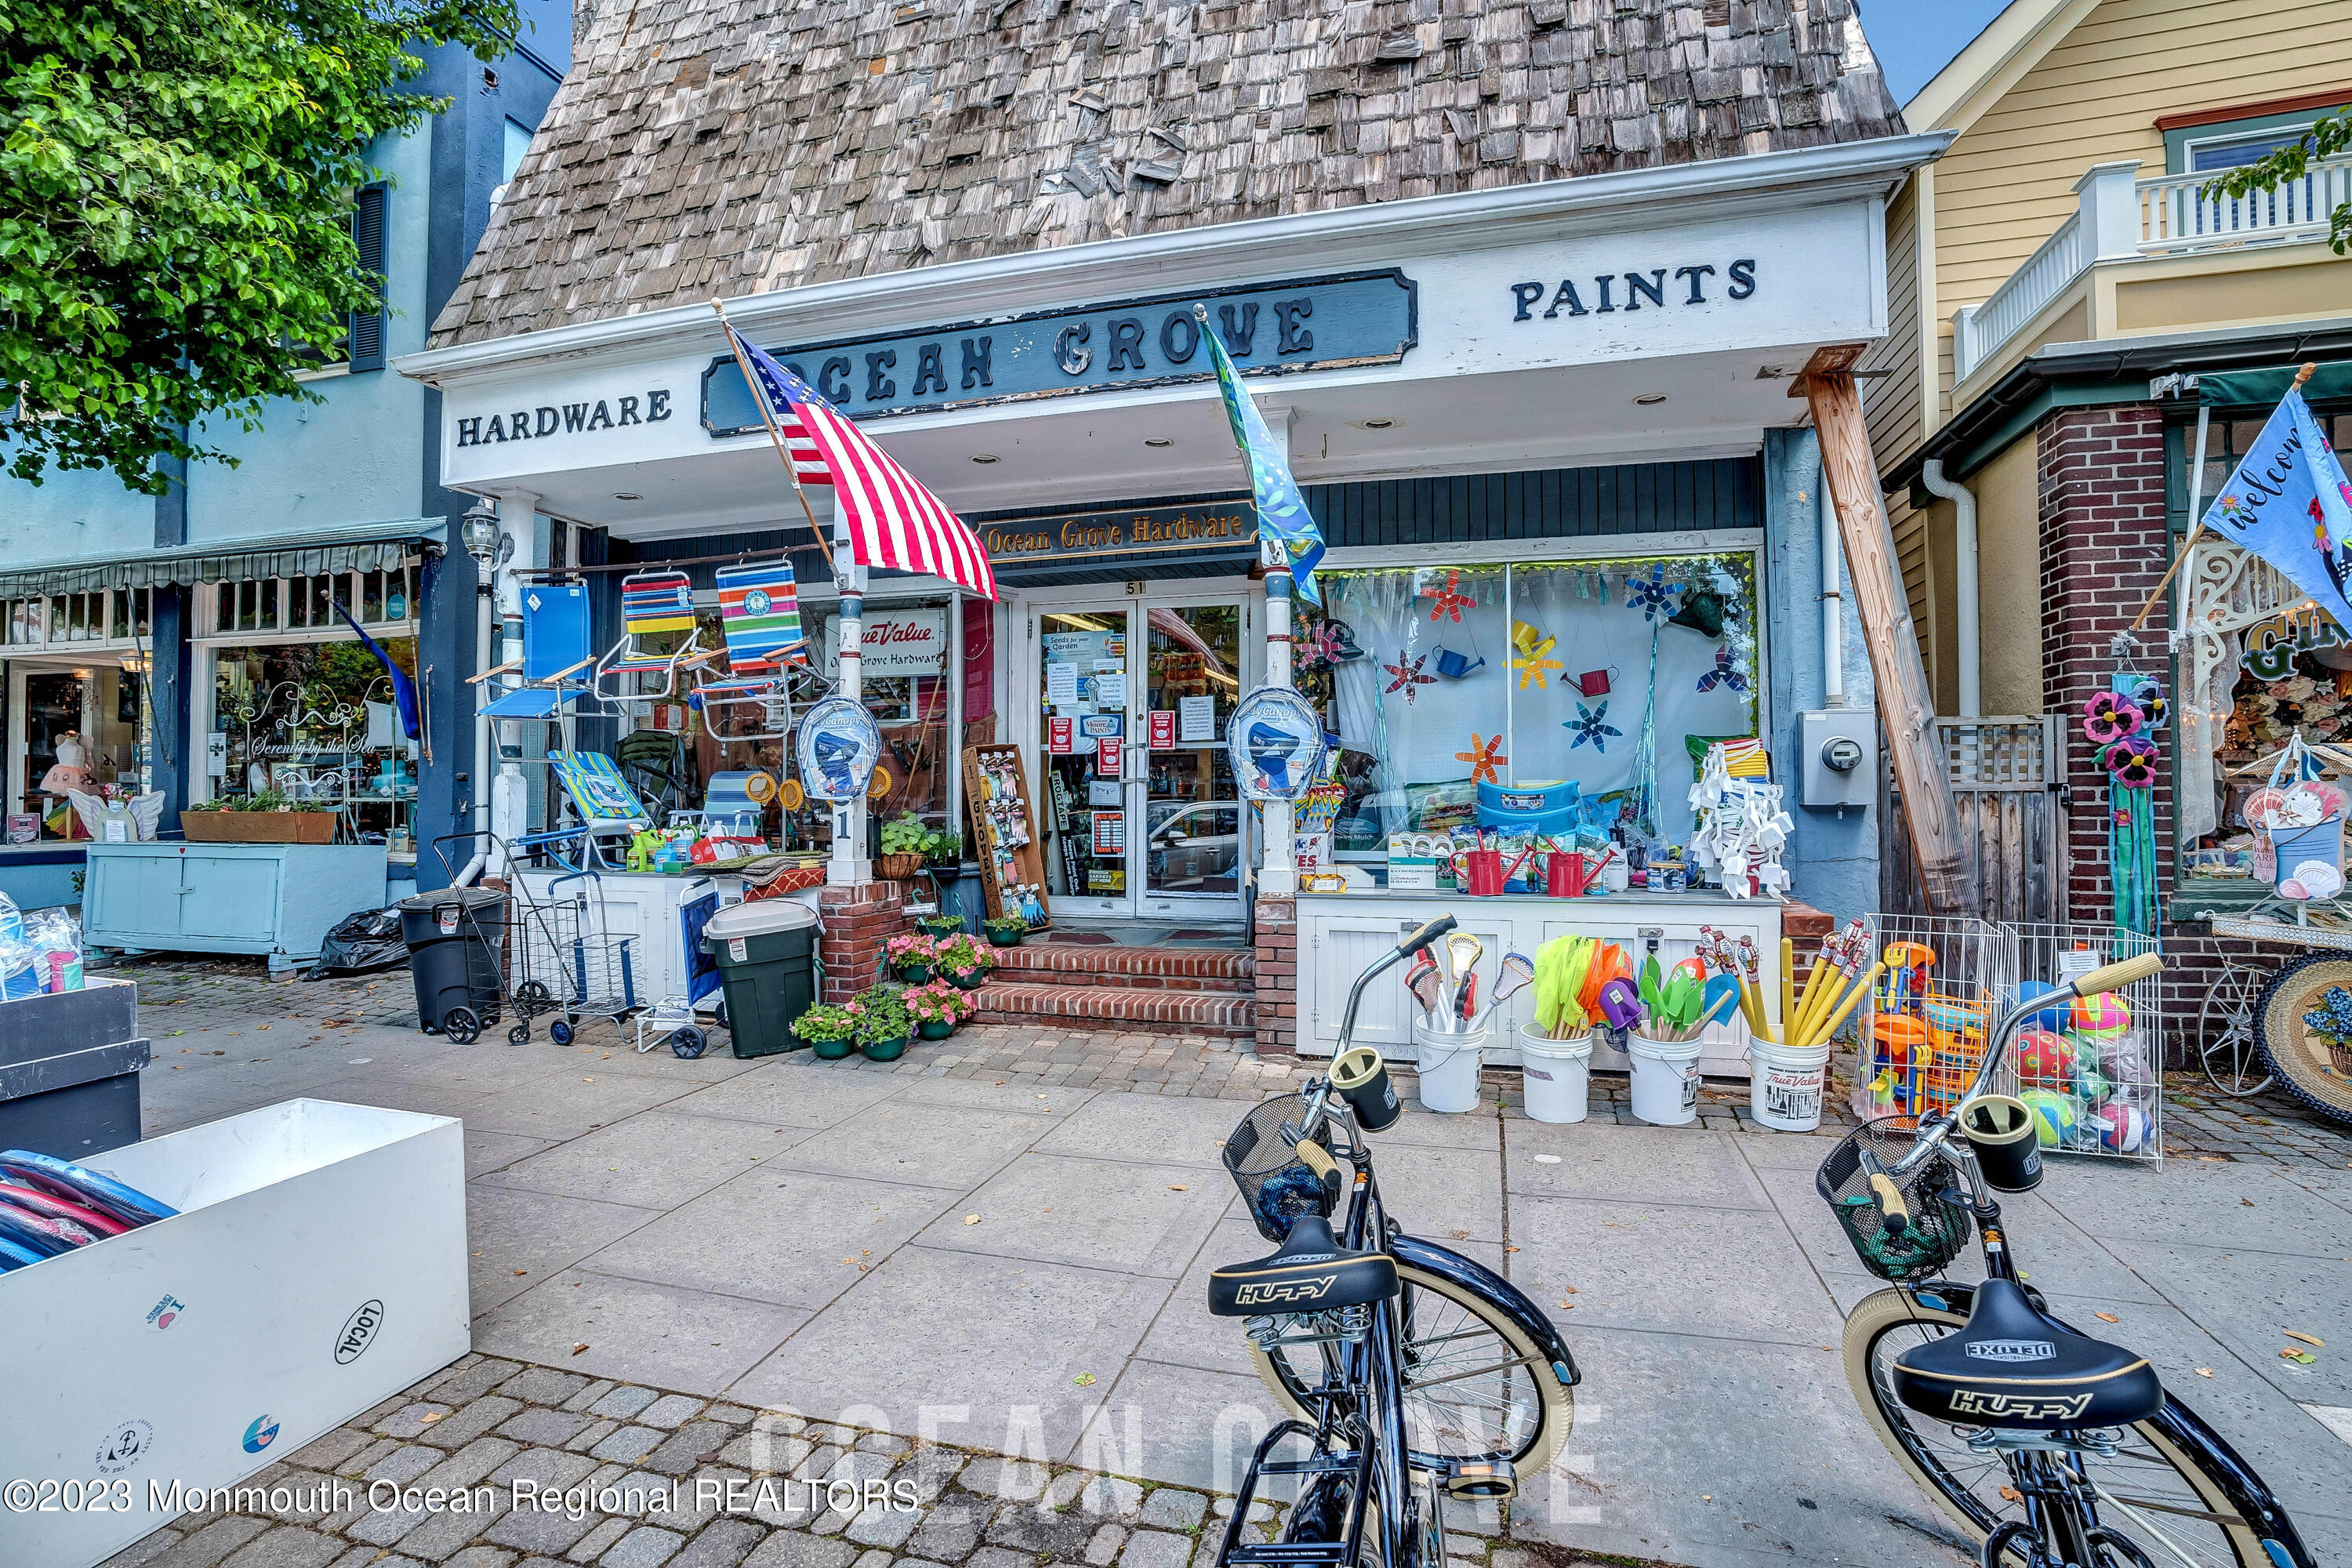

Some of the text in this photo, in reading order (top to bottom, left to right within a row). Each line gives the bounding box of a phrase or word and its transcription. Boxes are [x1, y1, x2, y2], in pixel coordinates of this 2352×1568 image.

[1512, 260, 1756, 322] PAINTS
[1053, 297, 1314, 376] GROVE
[457, 390, 672, 447] HARDWARE
[2228, 426, 2305, 531] welcom
[988, 513, 1243, 554] Ocean Grove Hardware
[1127, 583, 1143, 593] 51
[891, 653, 941, 664] Hardware
[251, 734, 376, 763] Serenity by the Sea
[1052, 772, 1068, 829] FROGTAPE
[837, 811, 851, 839] 1
[973, 800, 993, 884] GLOVES
[1295, 855, 1316, 866] ES
[1235, 1275, 1338, 1305] HUFFY
[339, 1307, 380, 1355] LOCAL
[1969, 1344, 2053, 1356] DELUXE
[1949, 1389, 2094, 1420] HUFFY
